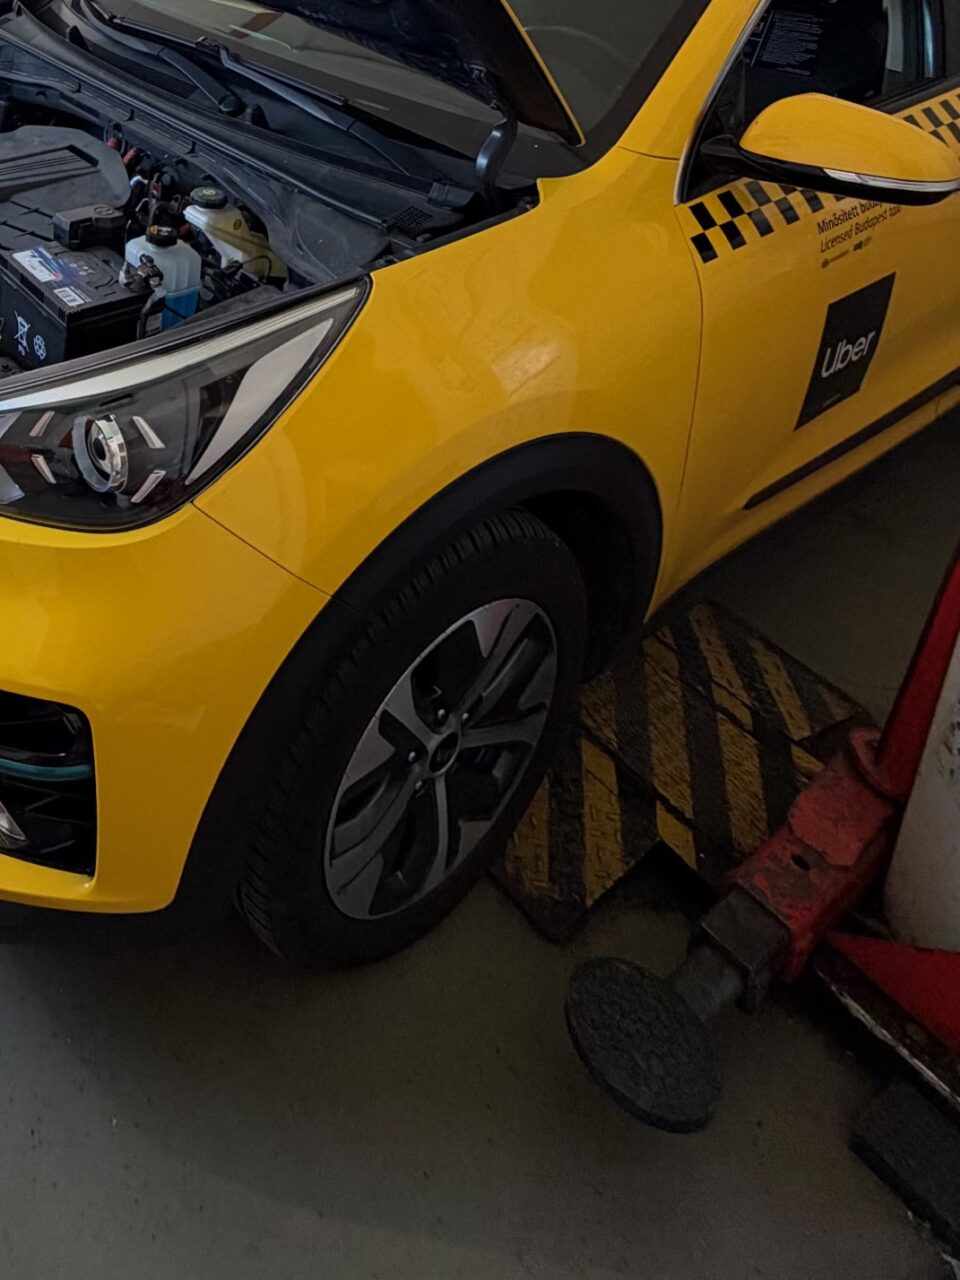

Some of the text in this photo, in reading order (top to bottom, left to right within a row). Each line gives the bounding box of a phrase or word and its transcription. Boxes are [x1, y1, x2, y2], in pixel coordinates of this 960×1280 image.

[820, 224, 853, 253] Licensed
[854, 209, 888, 235] Budapest
[821, 331, 876, 378] Uber
